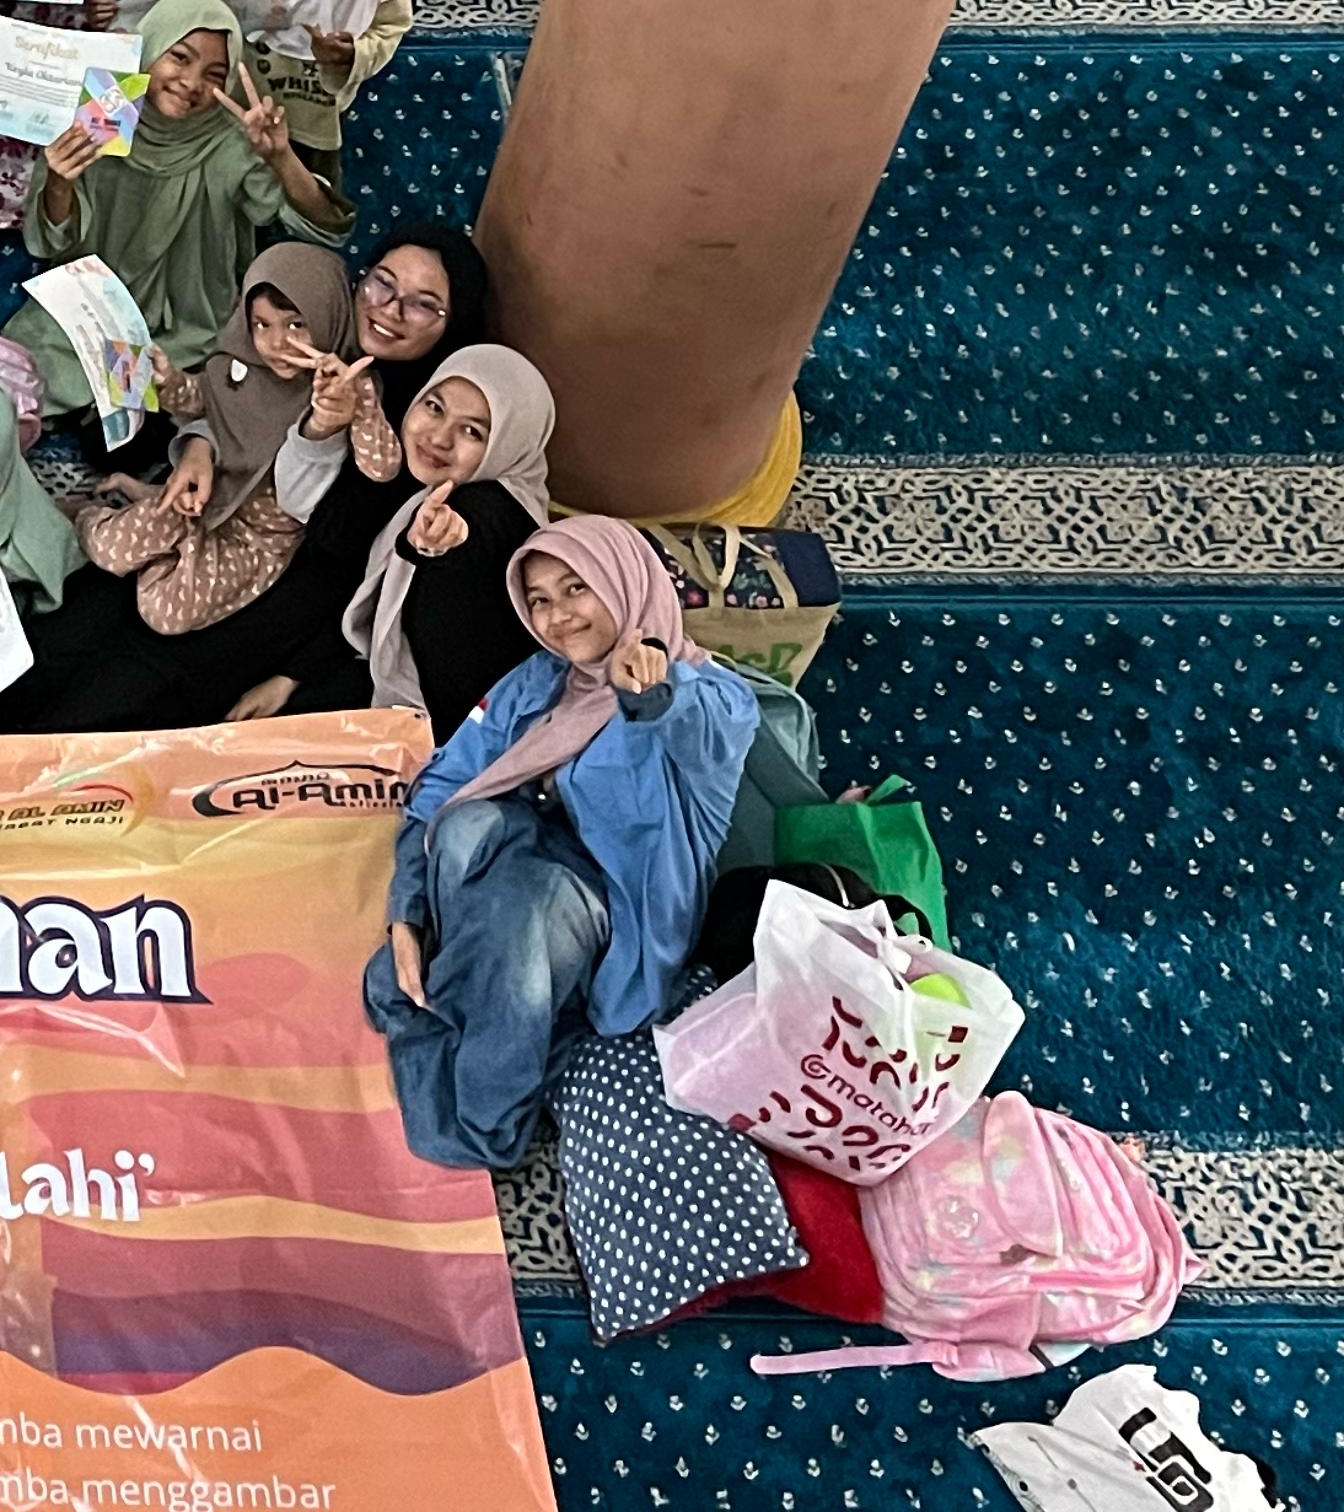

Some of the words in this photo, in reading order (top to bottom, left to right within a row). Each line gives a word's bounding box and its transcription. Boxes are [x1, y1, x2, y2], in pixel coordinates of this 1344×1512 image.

[15, 37, 79, 60] Sertifikat
[75, 1417, 263, 1453] mewarnai
[82, 1476, 336, 1512] menggambar
